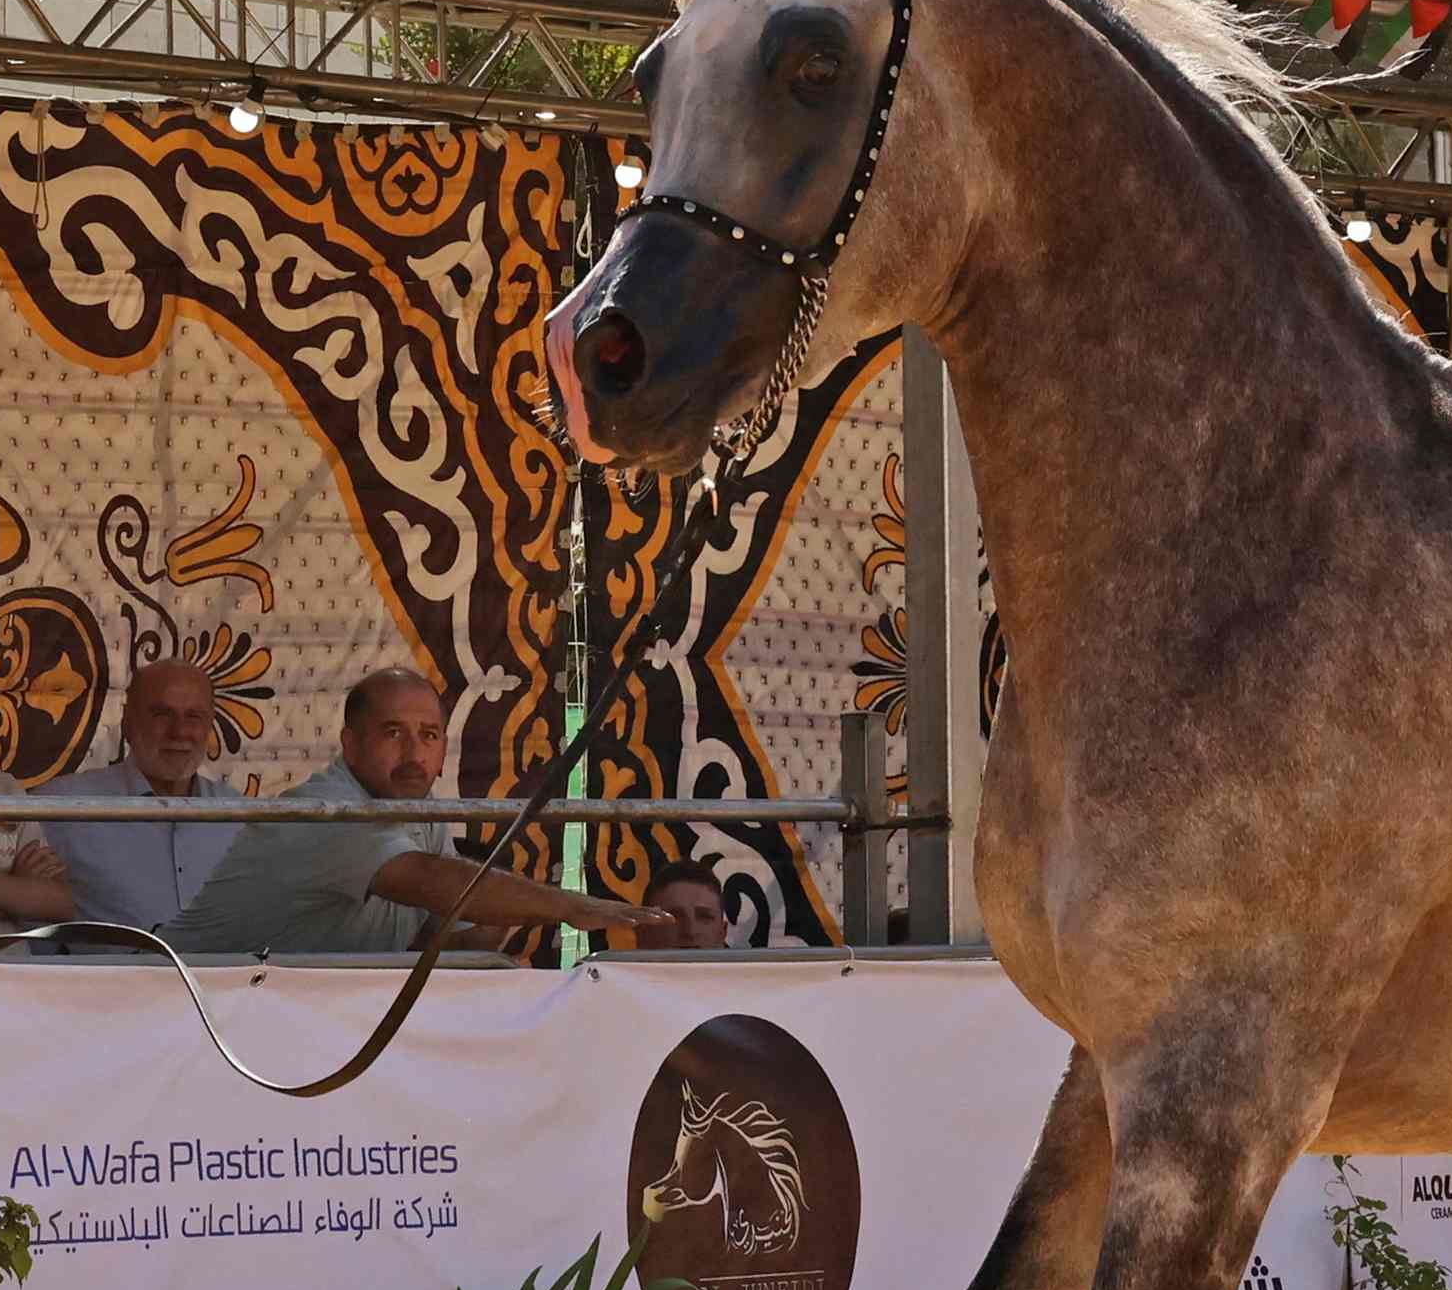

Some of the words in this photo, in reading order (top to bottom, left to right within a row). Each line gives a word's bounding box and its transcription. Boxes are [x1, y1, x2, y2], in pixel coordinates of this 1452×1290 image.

[10, 1141, 160, 1189] Al-Wafa
[169, 1138, 285, 1182] Plastic
[295, 1134, 458, 1178] Industries
[29, 1205, 170, 1256] البلاستيكي
[181, 1200, 304, 1240] للصناعات
[314, 1198, 381, 1242] الوفاء
[393, 1191, 459, 1240] شركة
